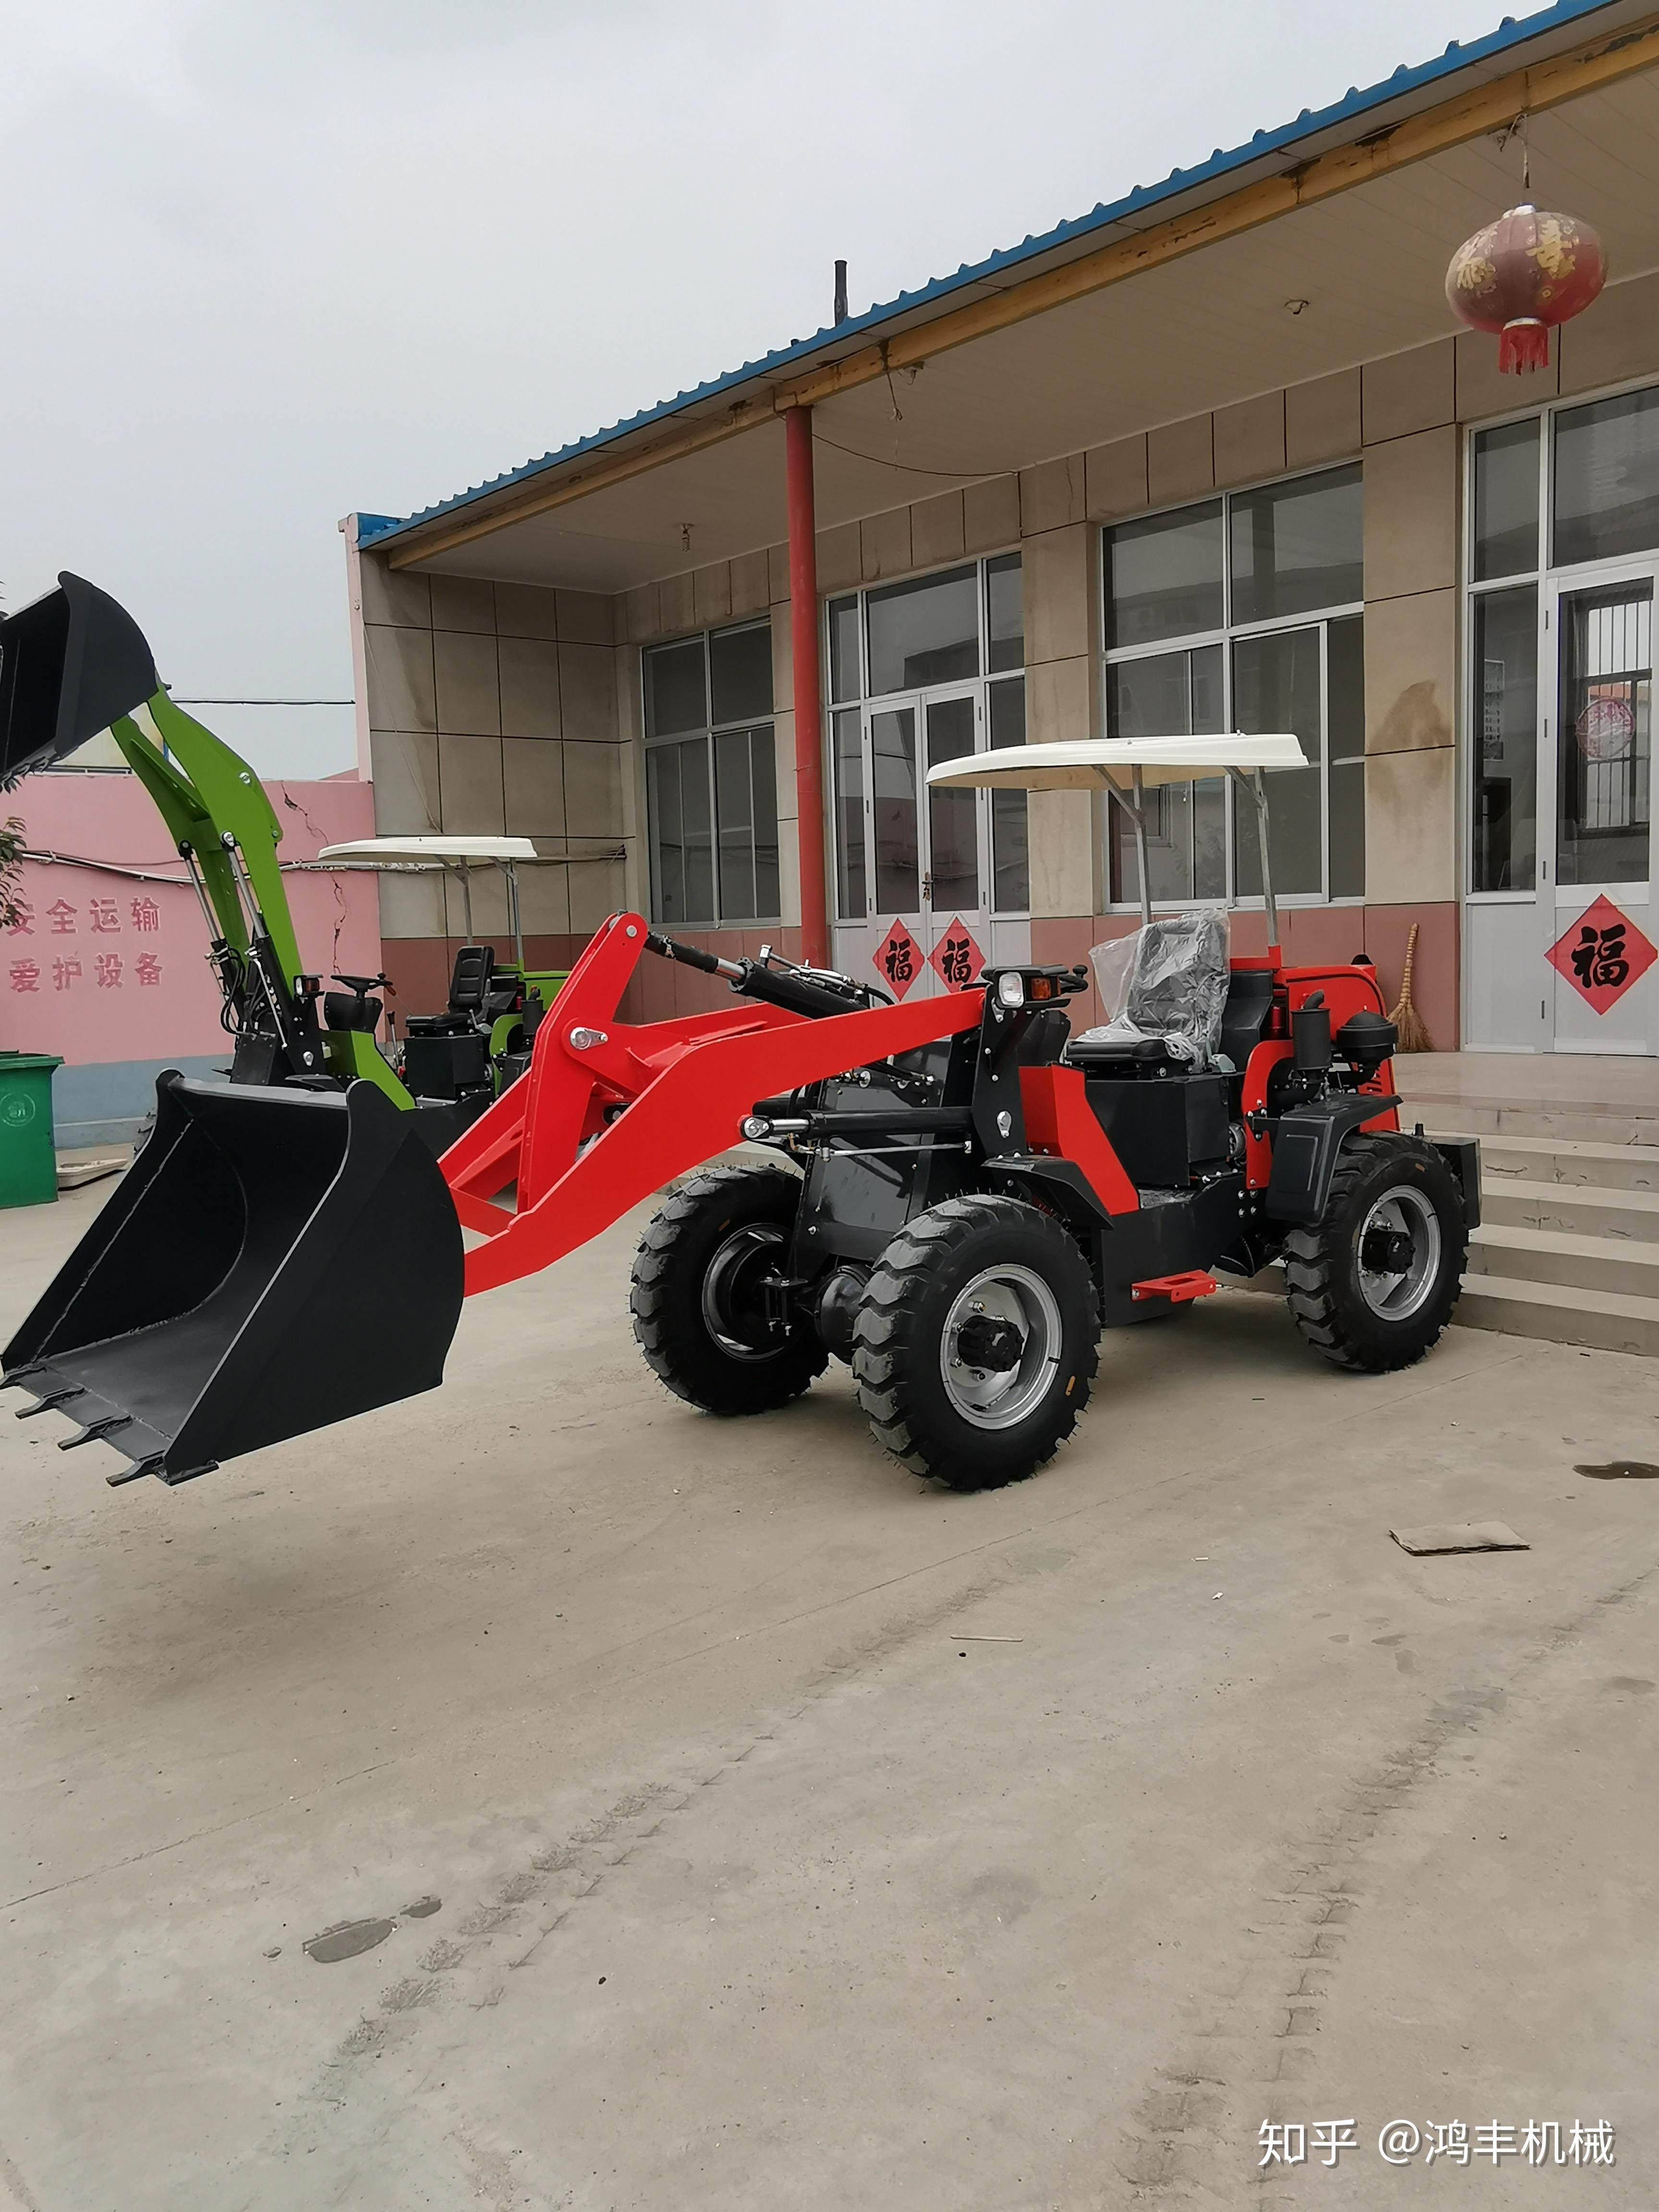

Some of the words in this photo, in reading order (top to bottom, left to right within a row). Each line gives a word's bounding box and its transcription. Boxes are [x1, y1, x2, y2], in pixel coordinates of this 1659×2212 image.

[6, 896, 160, 936] 安全运输
[9, 951, 164, 993] 爱护设备
[885, 938, 913, 982] 福
[941, 938, 972, 983] 福
[1571, 924, 1629, 988] 福
